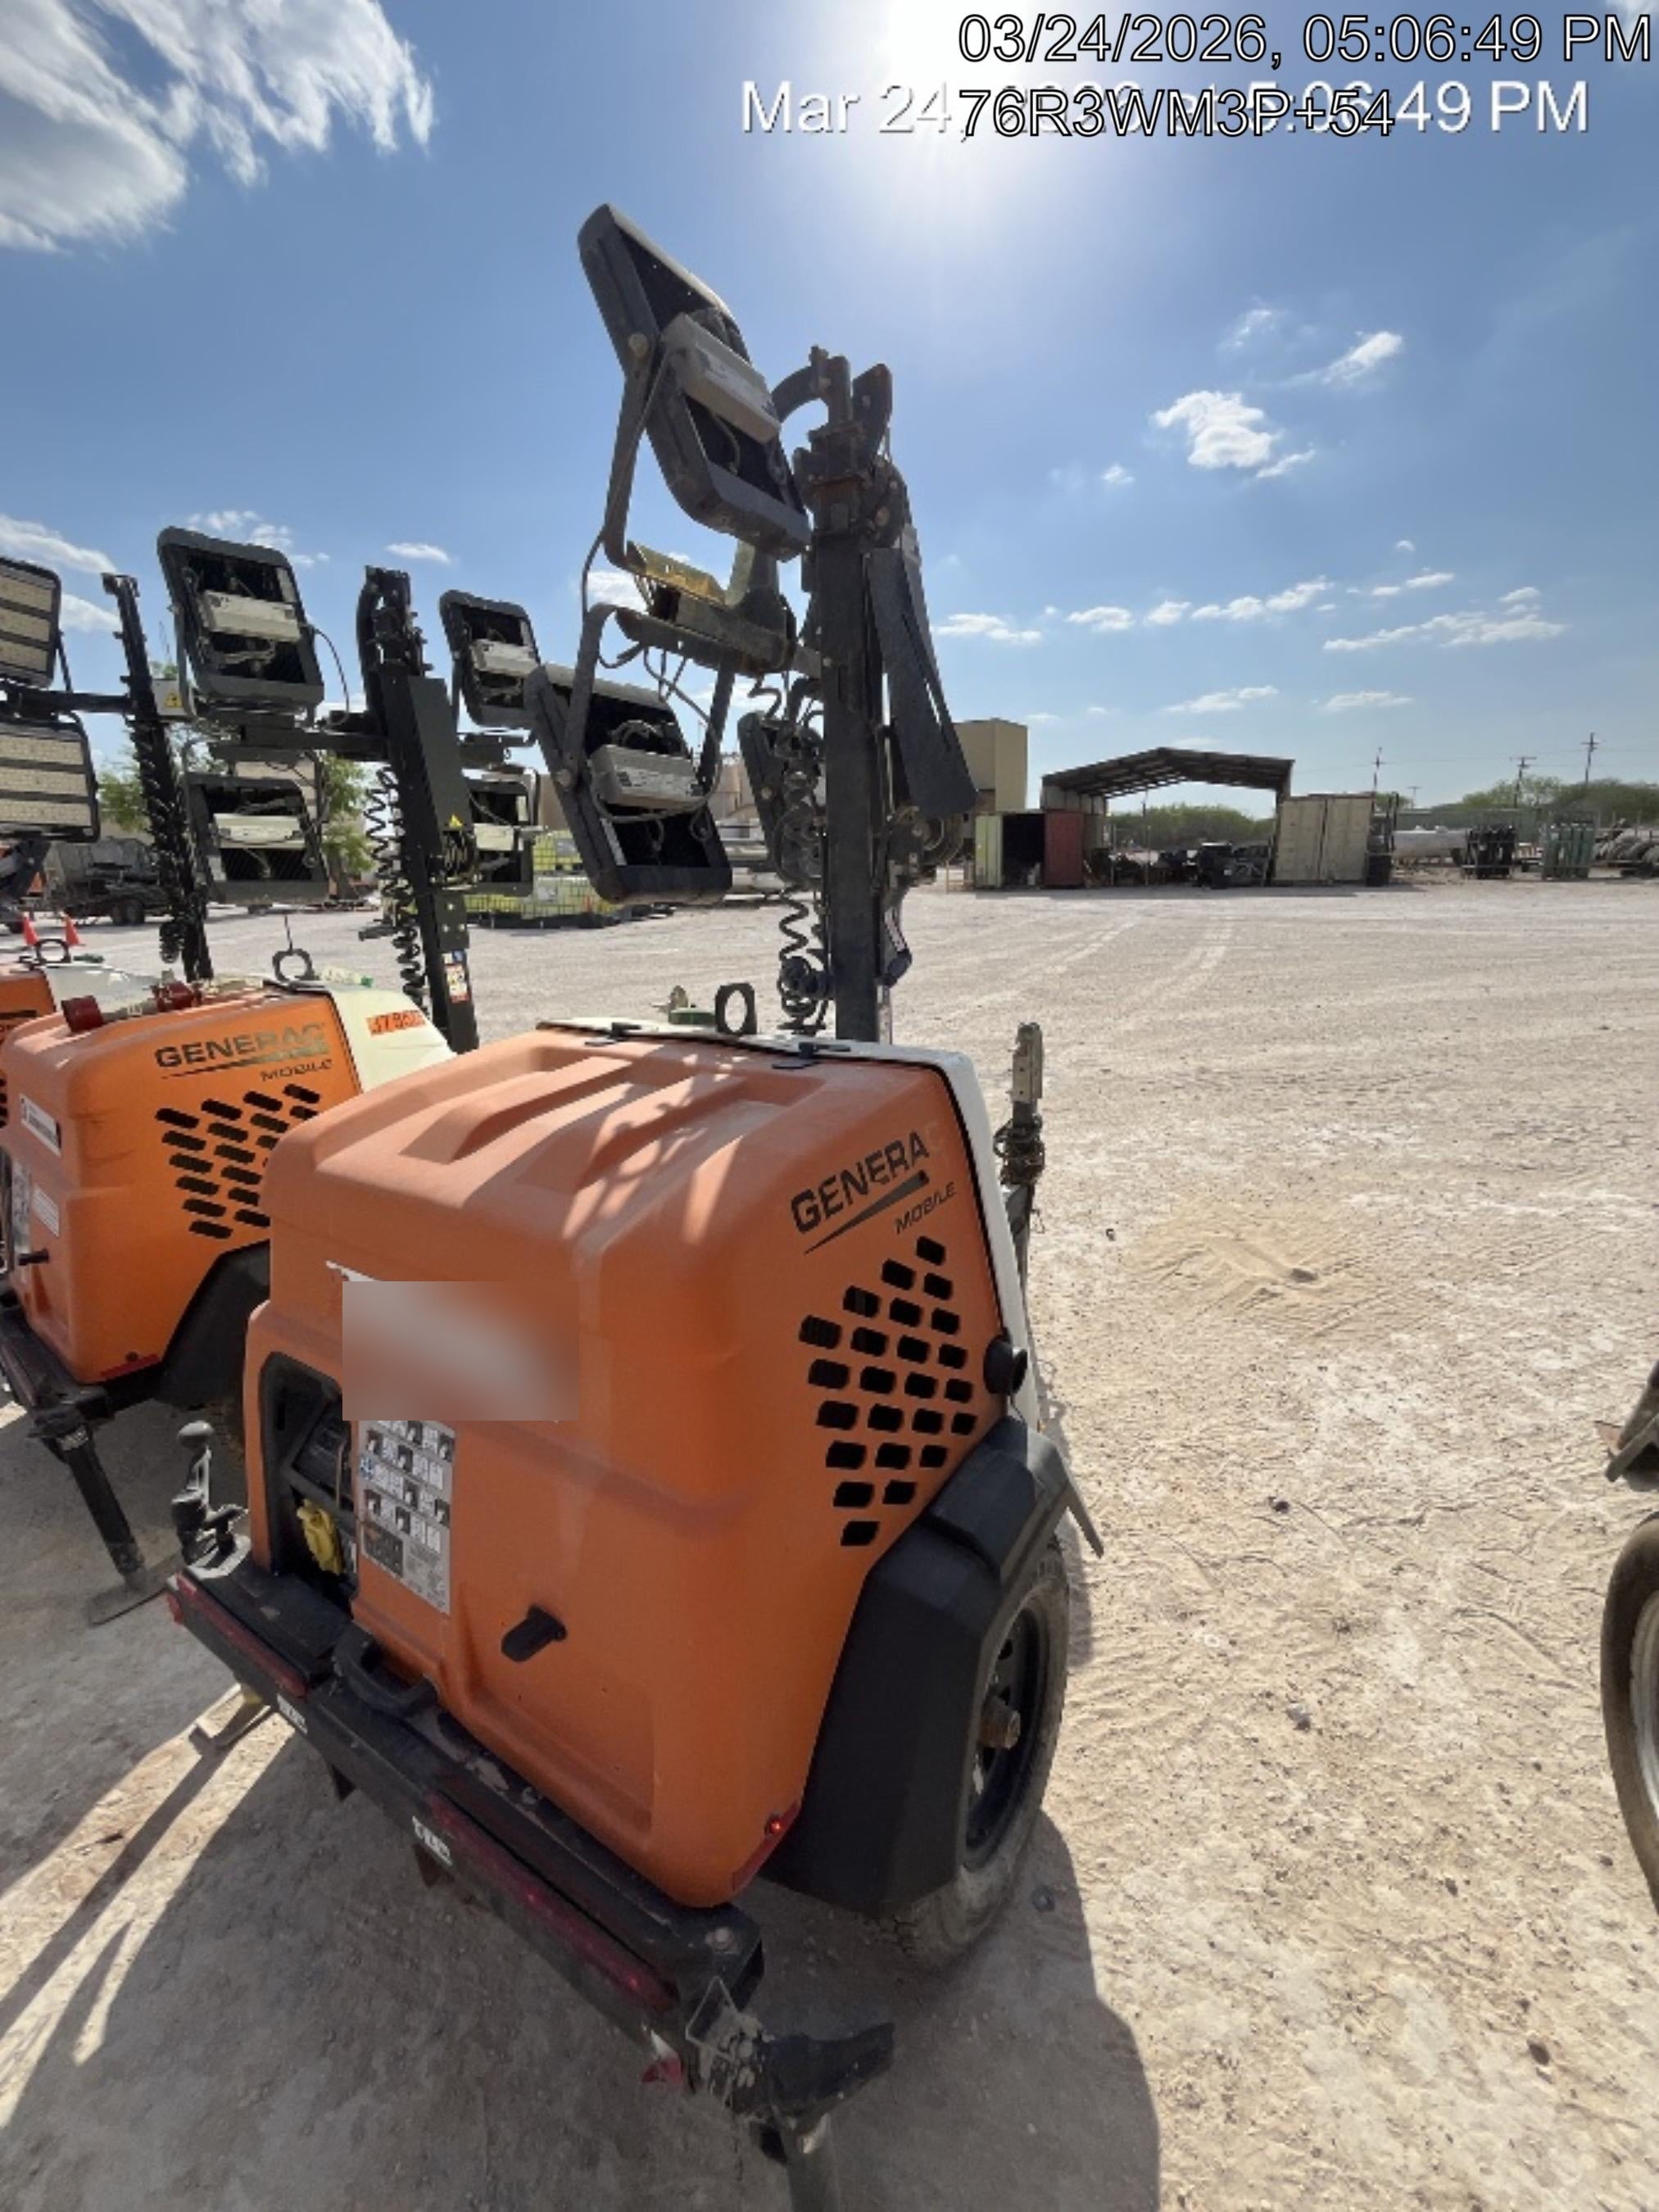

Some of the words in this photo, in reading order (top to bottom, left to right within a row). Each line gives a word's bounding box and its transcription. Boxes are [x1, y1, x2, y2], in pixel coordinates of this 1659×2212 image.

[156, 1022, 324, 1067] GENERAC
[261, 1059, 333, 1082] MOBILE
[895, 1181, 957, 1235] MOBILE
